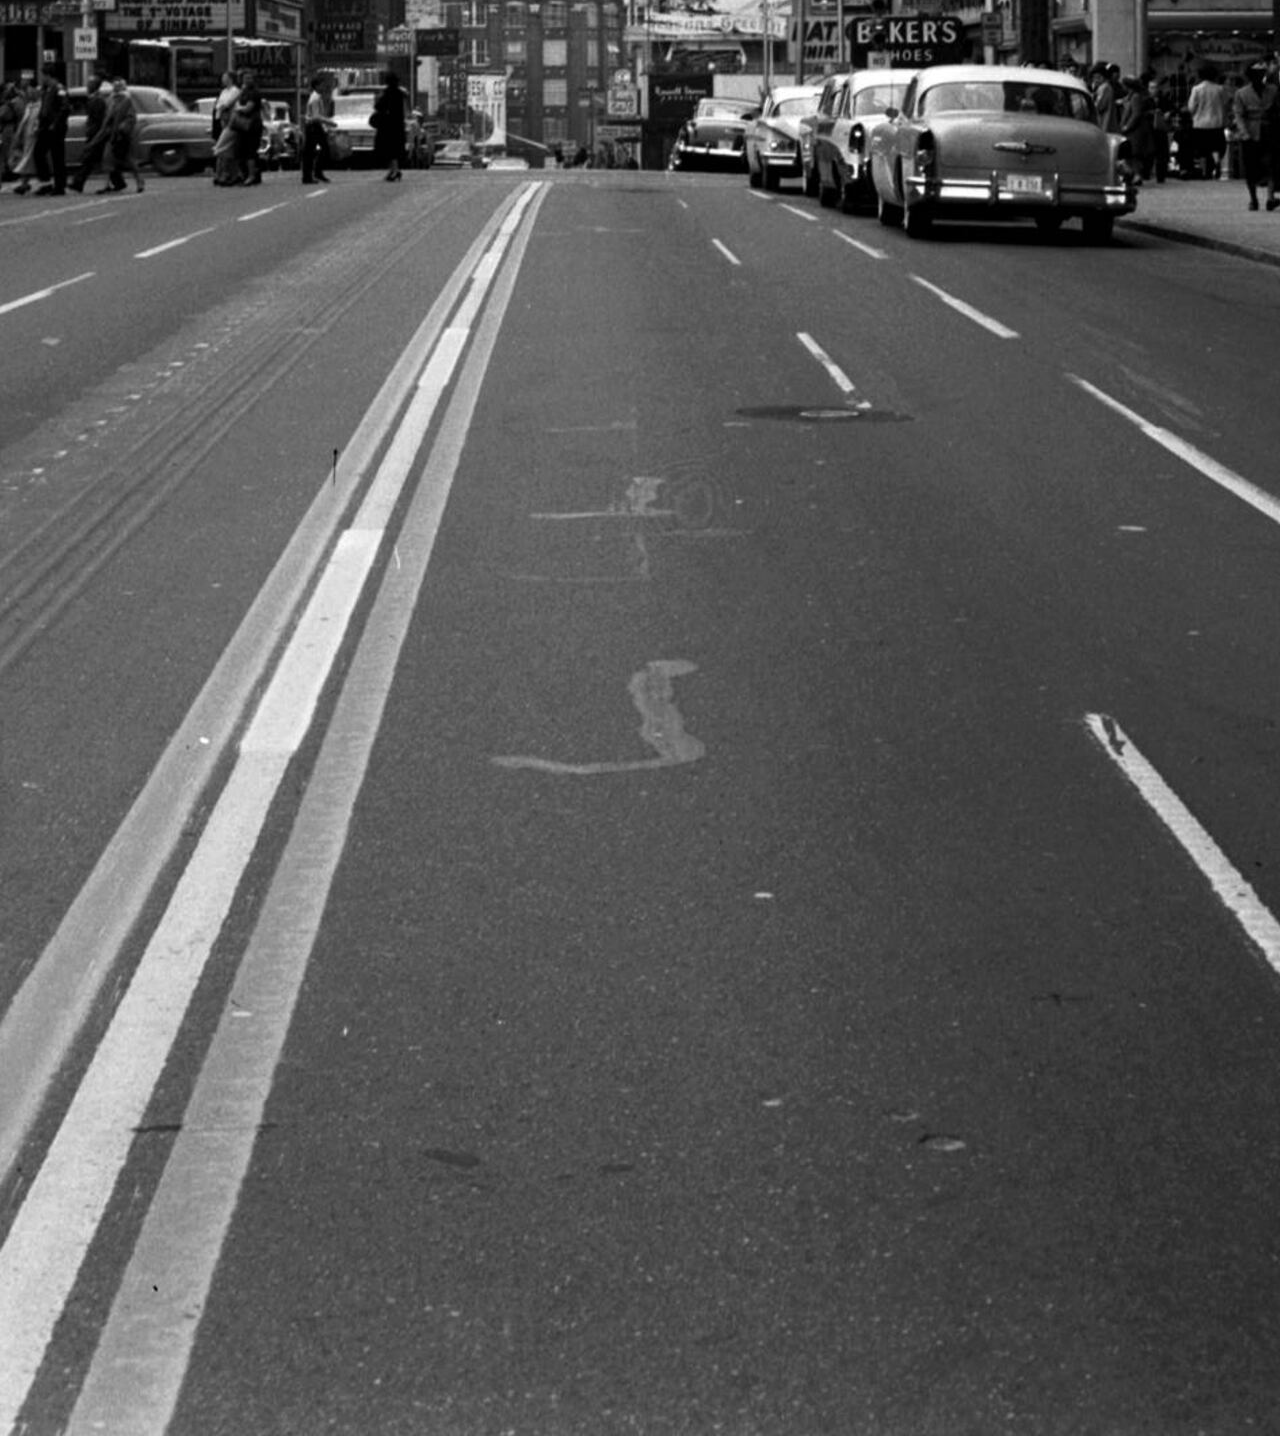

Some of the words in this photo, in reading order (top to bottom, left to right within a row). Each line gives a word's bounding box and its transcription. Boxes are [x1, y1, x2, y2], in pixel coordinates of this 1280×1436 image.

[166, 7, 212, 18] VOYAGE
[856, 20, 958, 44] BKER'S
[889, 48, 933, 62] HOES
